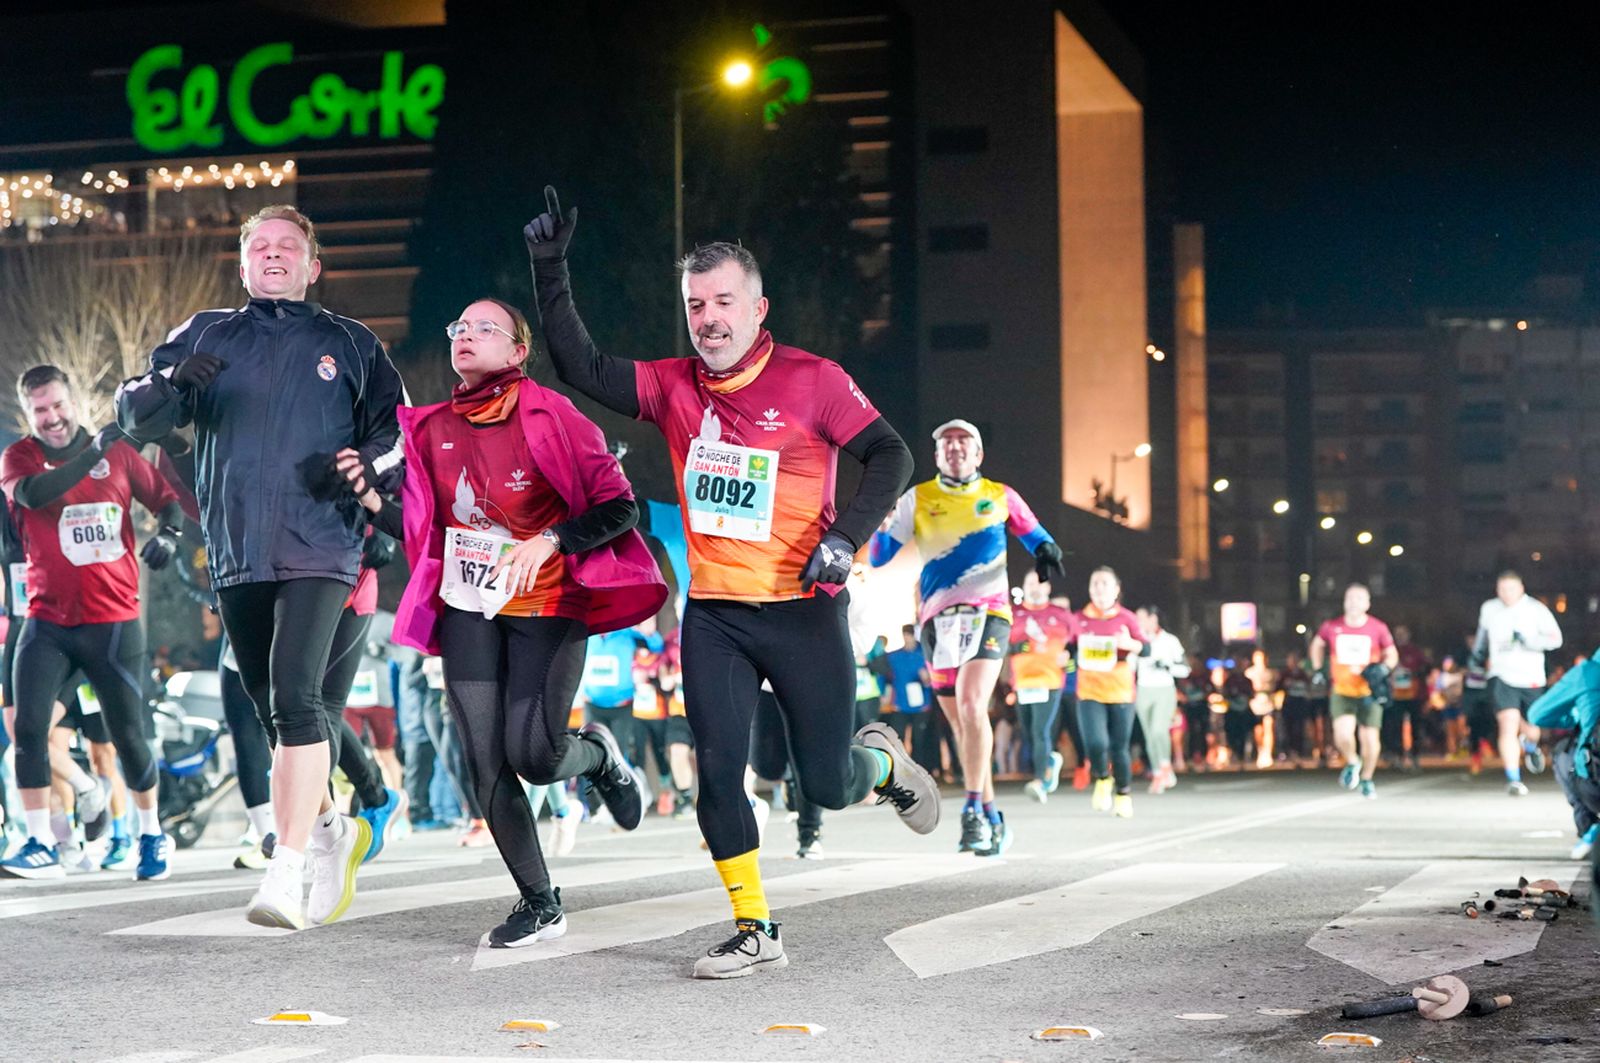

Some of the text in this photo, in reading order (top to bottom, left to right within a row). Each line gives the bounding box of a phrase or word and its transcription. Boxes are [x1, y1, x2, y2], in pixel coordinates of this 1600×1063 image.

[126, 42, 446, 152] El Corte
[694, 461, 710, 472] SAN
[710, 464, 740, 477] ANTÓN
[705, 451, 731, 463] NOCHE
[731, 455, 741, 466] DE
[695, 474, 757, 509] 8092
[462, 539, 493, 552] NOCHE DE
[460, 560, 500, 591] 1672
